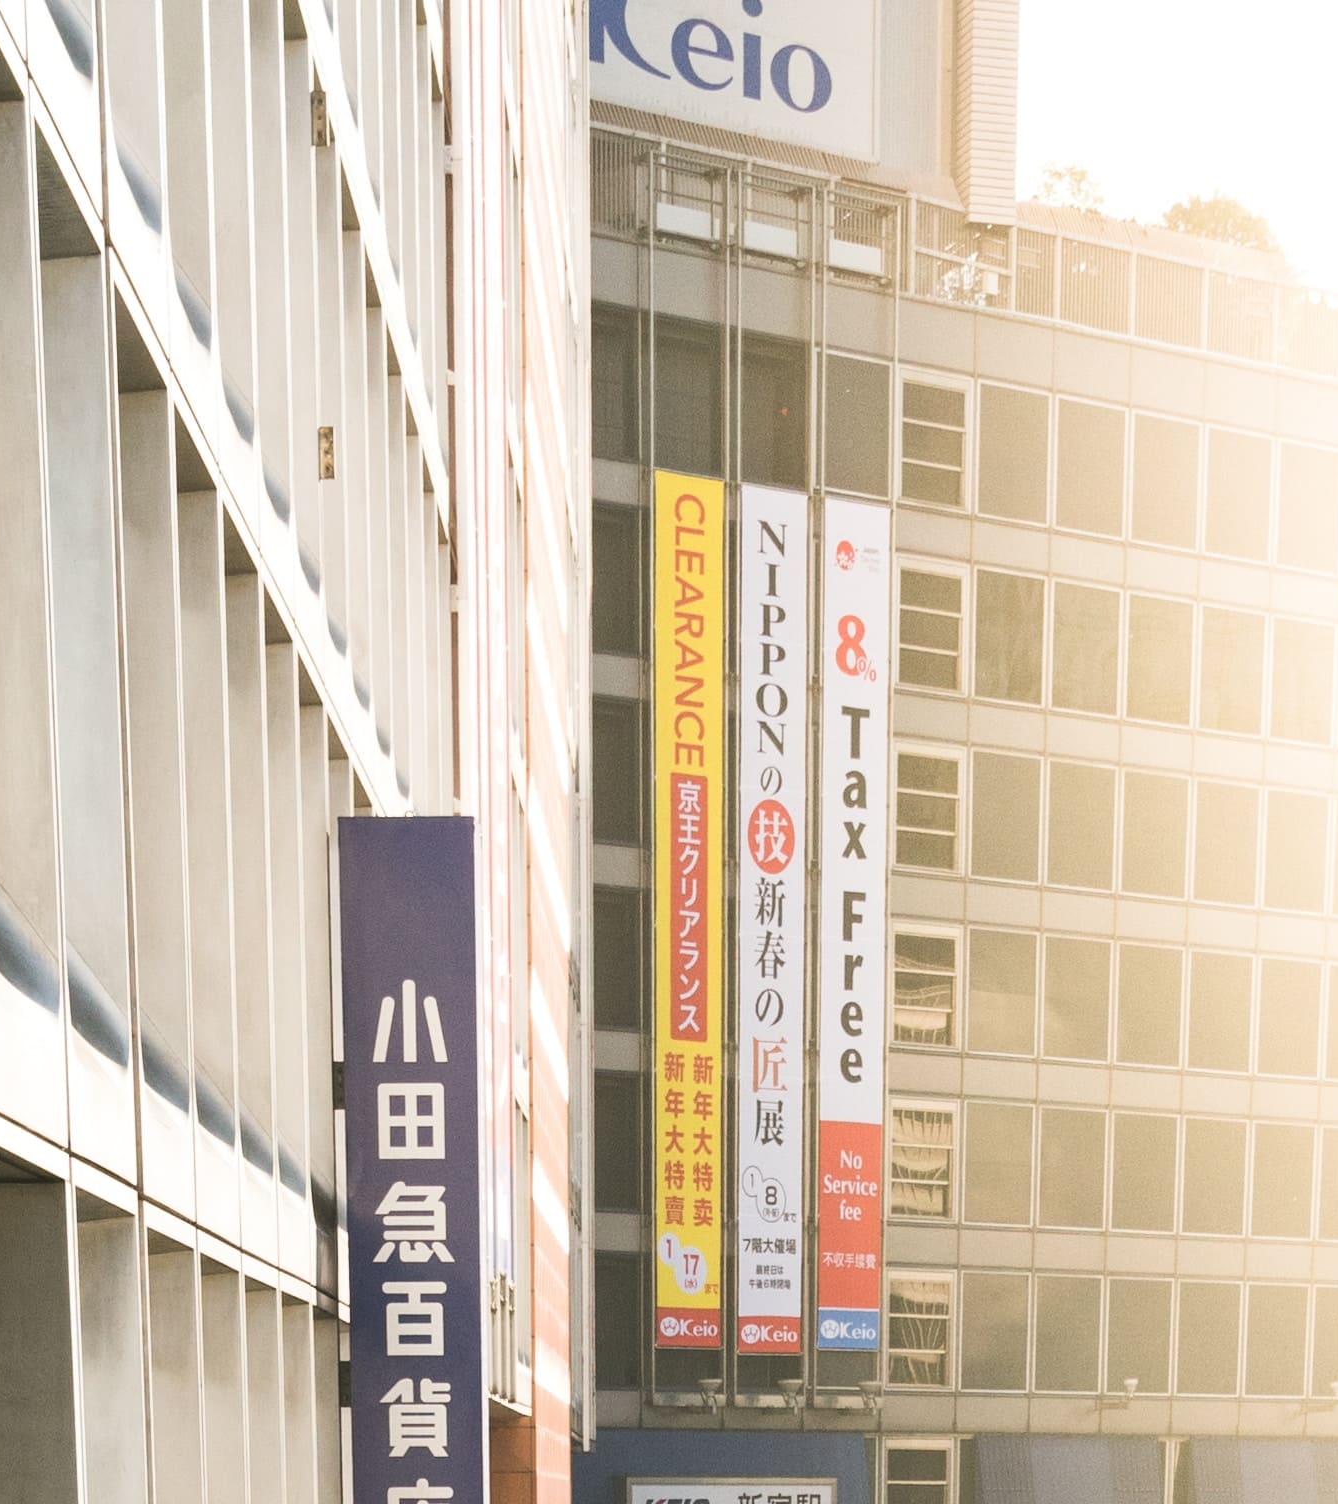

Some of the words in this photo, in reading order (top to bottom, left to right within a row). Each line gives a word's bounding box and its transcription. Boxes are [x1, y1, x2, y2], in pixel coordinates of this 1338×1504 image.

[673, 493, 707, 768] CLEARANCE
[835, 614, 878, 683] 8%
[841, 705, 871, 861] Tax
[677, 780, 703, 1034] 京王クリアランス
[840, 889, 868, 1084] Free
[840, 1150, 863, 1169] No
[764, 1186, 779, 1206] 8
[823, 1174, 878, 1197] Service
[839, 1200, 862, 1221] fee
[683, 1253, 700, 1276] 17
[679, 1319, 719, 1338] Keio
[759, 1323, 799, 1343] Keio
[838, 1320, 877, 1340] Keio
